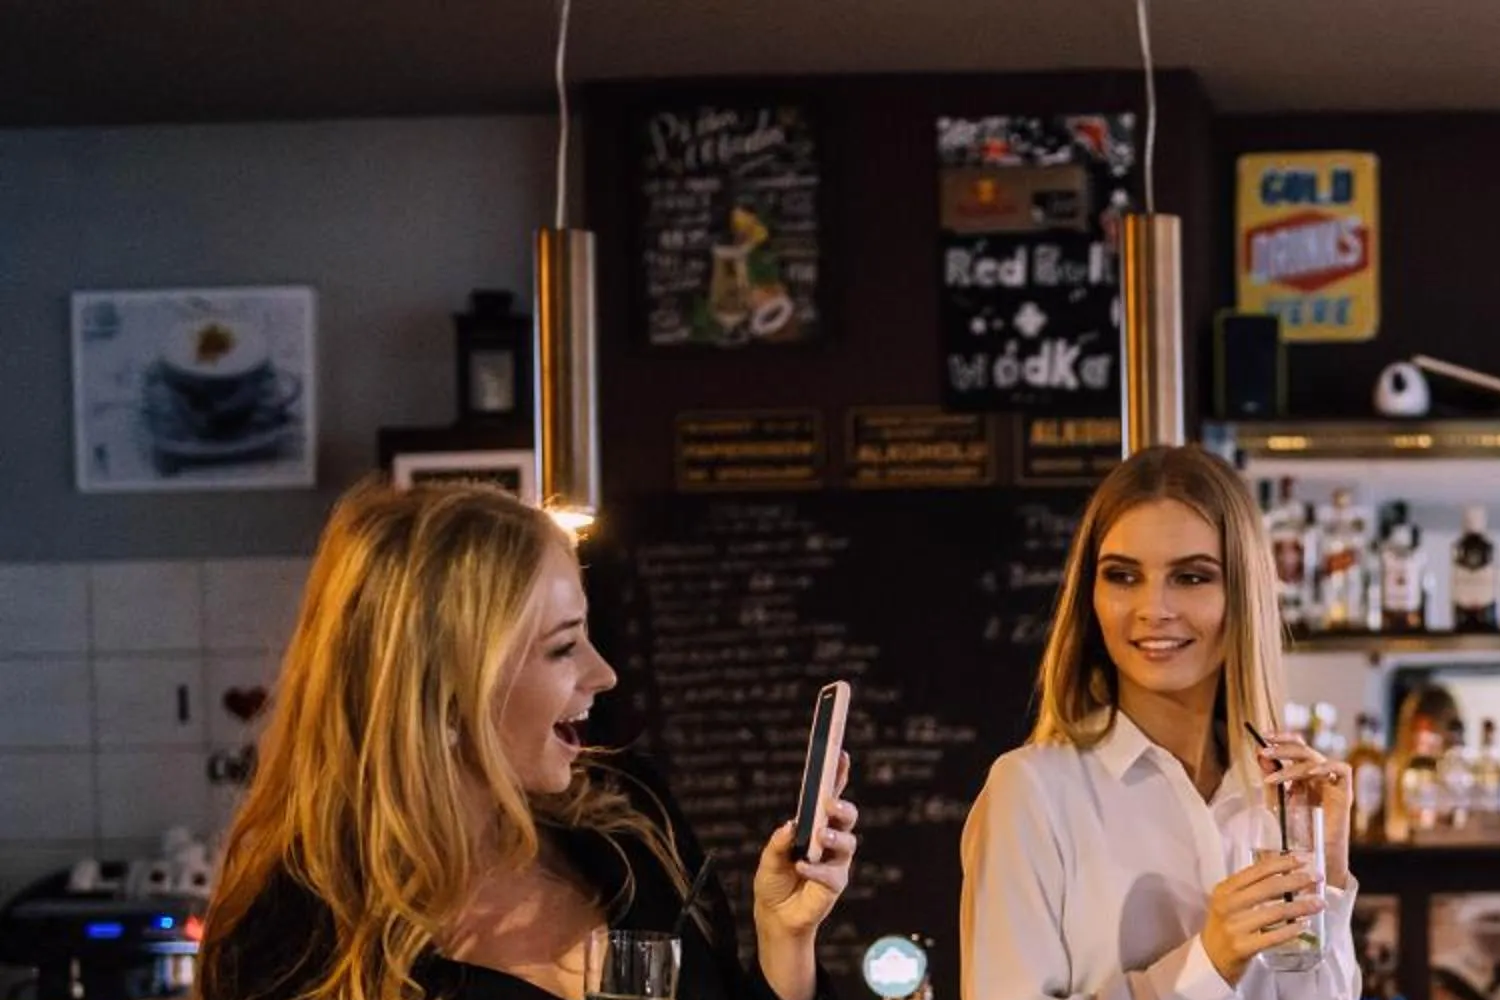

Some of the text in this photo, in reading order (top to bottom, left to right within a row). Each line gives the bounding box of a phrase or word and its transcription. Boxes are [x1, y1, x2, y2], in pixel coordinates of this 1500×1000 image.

[1260, 169, 1353, 205] COLD
[944, 243, 1026, 288] Red
[1248, 215, 1364, 284] DRINKS
